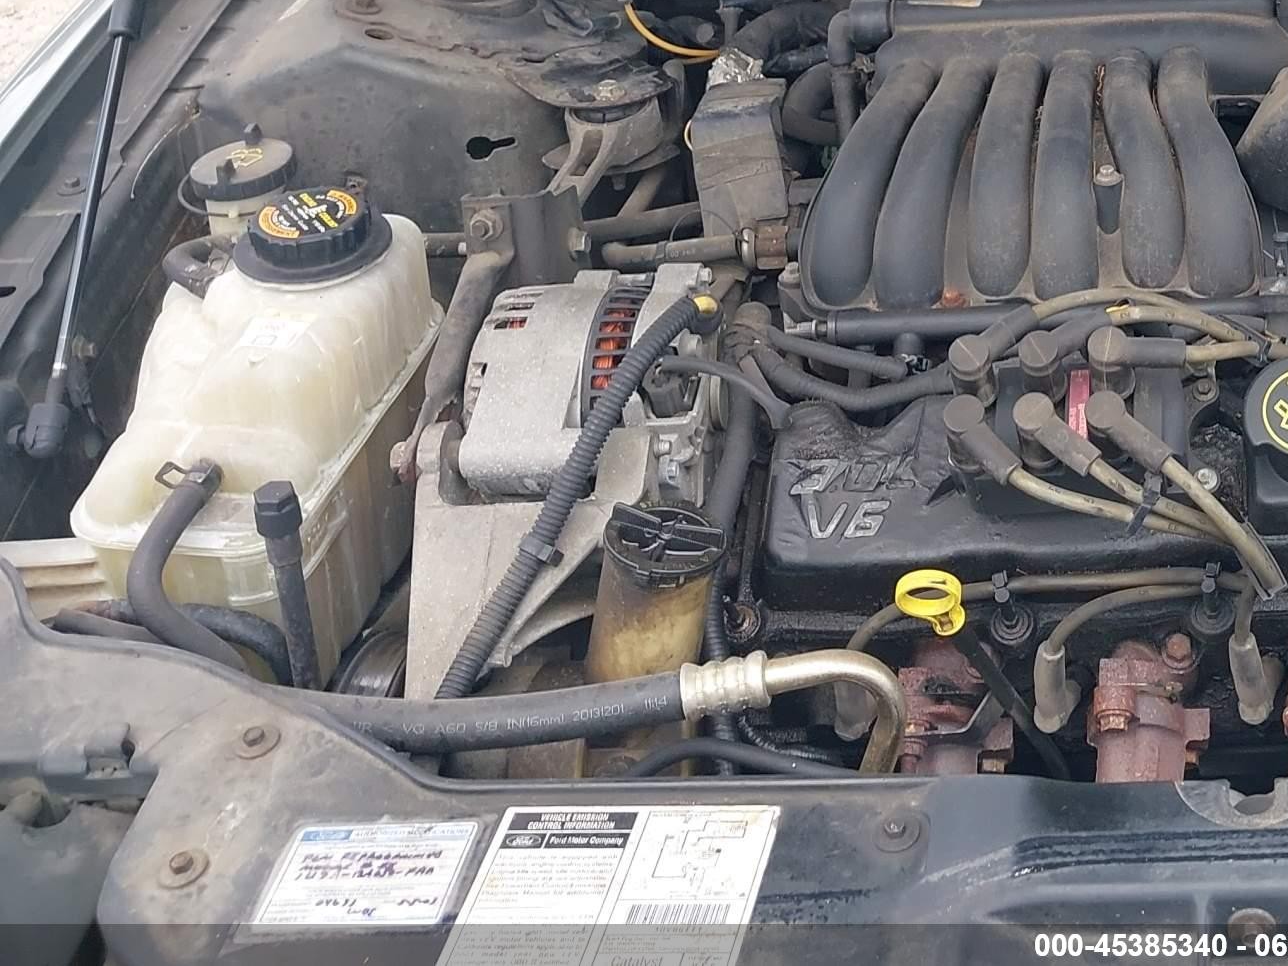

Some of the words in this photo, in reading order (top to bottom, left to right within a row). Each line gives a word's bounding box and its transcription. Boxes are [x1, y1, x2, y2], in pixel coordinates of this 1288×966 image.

[807, 499, 891, 539] V6
[475, 721, 498, 731] 5/8
[540, 812, 571, 821] VEHICLE
[572, 812, 610, 821] EMISSION
[527, 821, 562, 830] CONTROL
[563, 821, 616, 830] INFORMATION
[549, 835, 567, 844] Ford
[567, 835, 589, 844] Motor
[589, 835, 624, 846] Company
